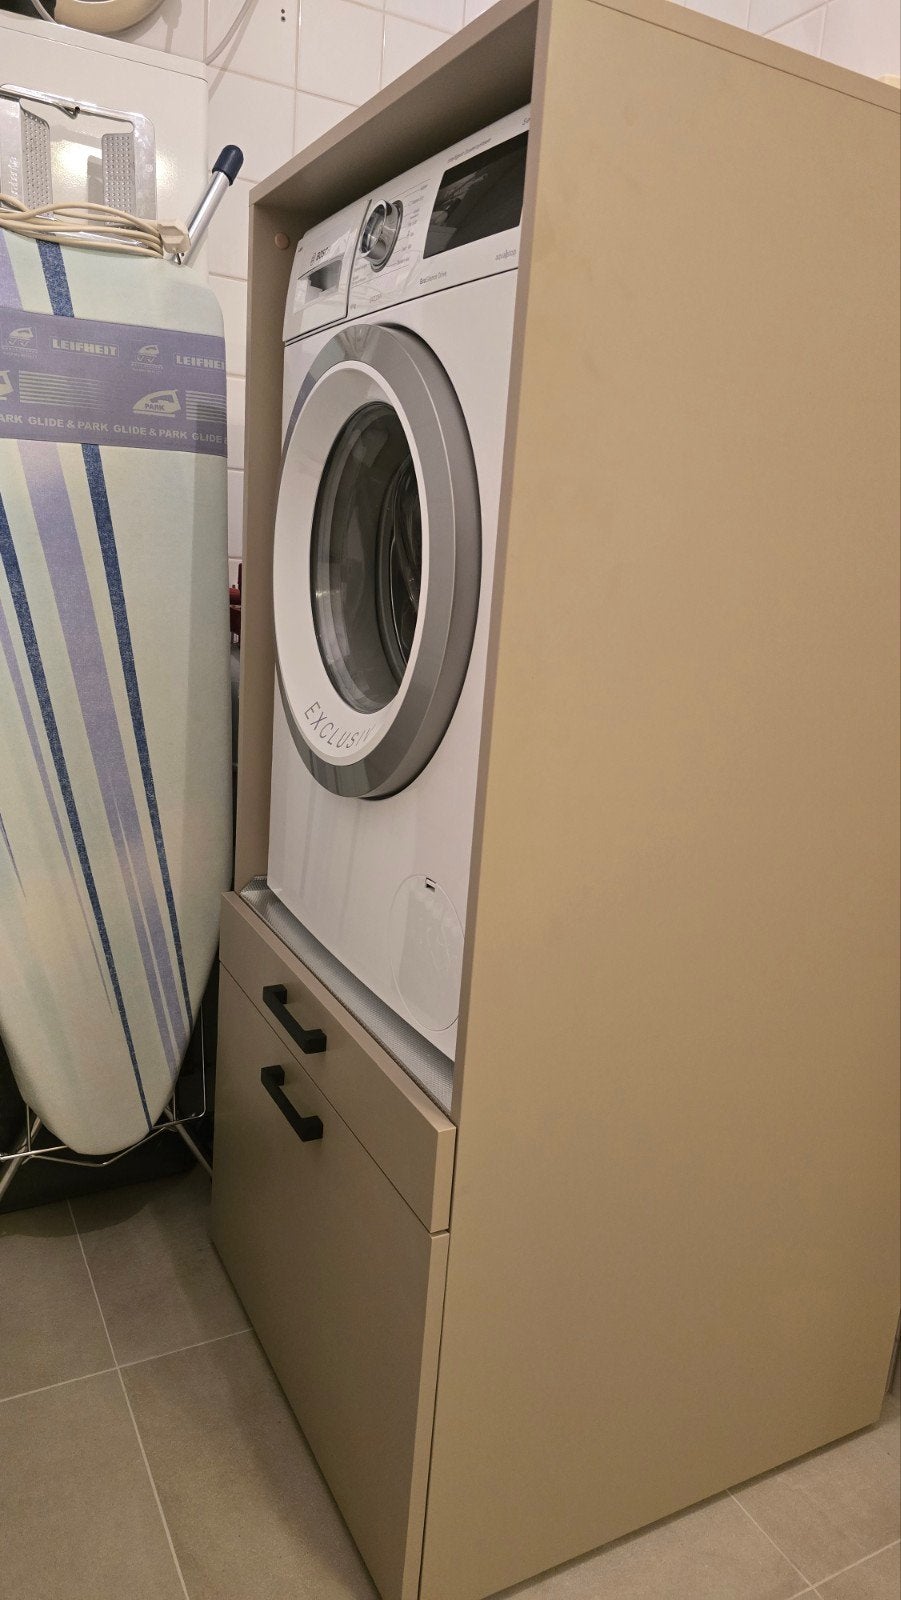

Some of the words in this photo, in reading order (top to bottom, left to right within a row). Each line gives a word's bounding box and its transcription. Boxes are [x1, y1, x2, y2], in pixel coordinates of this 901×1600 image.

[52, 338, 119, 357] LEIFHEIT
[144, 402, 165, 411] PARK
[28, 416, 64, 428] GLIDE
[66, 419, 76, 429] &
[77, 421, 109, 432] PARK
[113, 424, 147, 436] GLIDE
[149, 427, 157, 437] &
[158, 429, 188, 440] PARK
[192, 433, 223, 443] GLIDE
